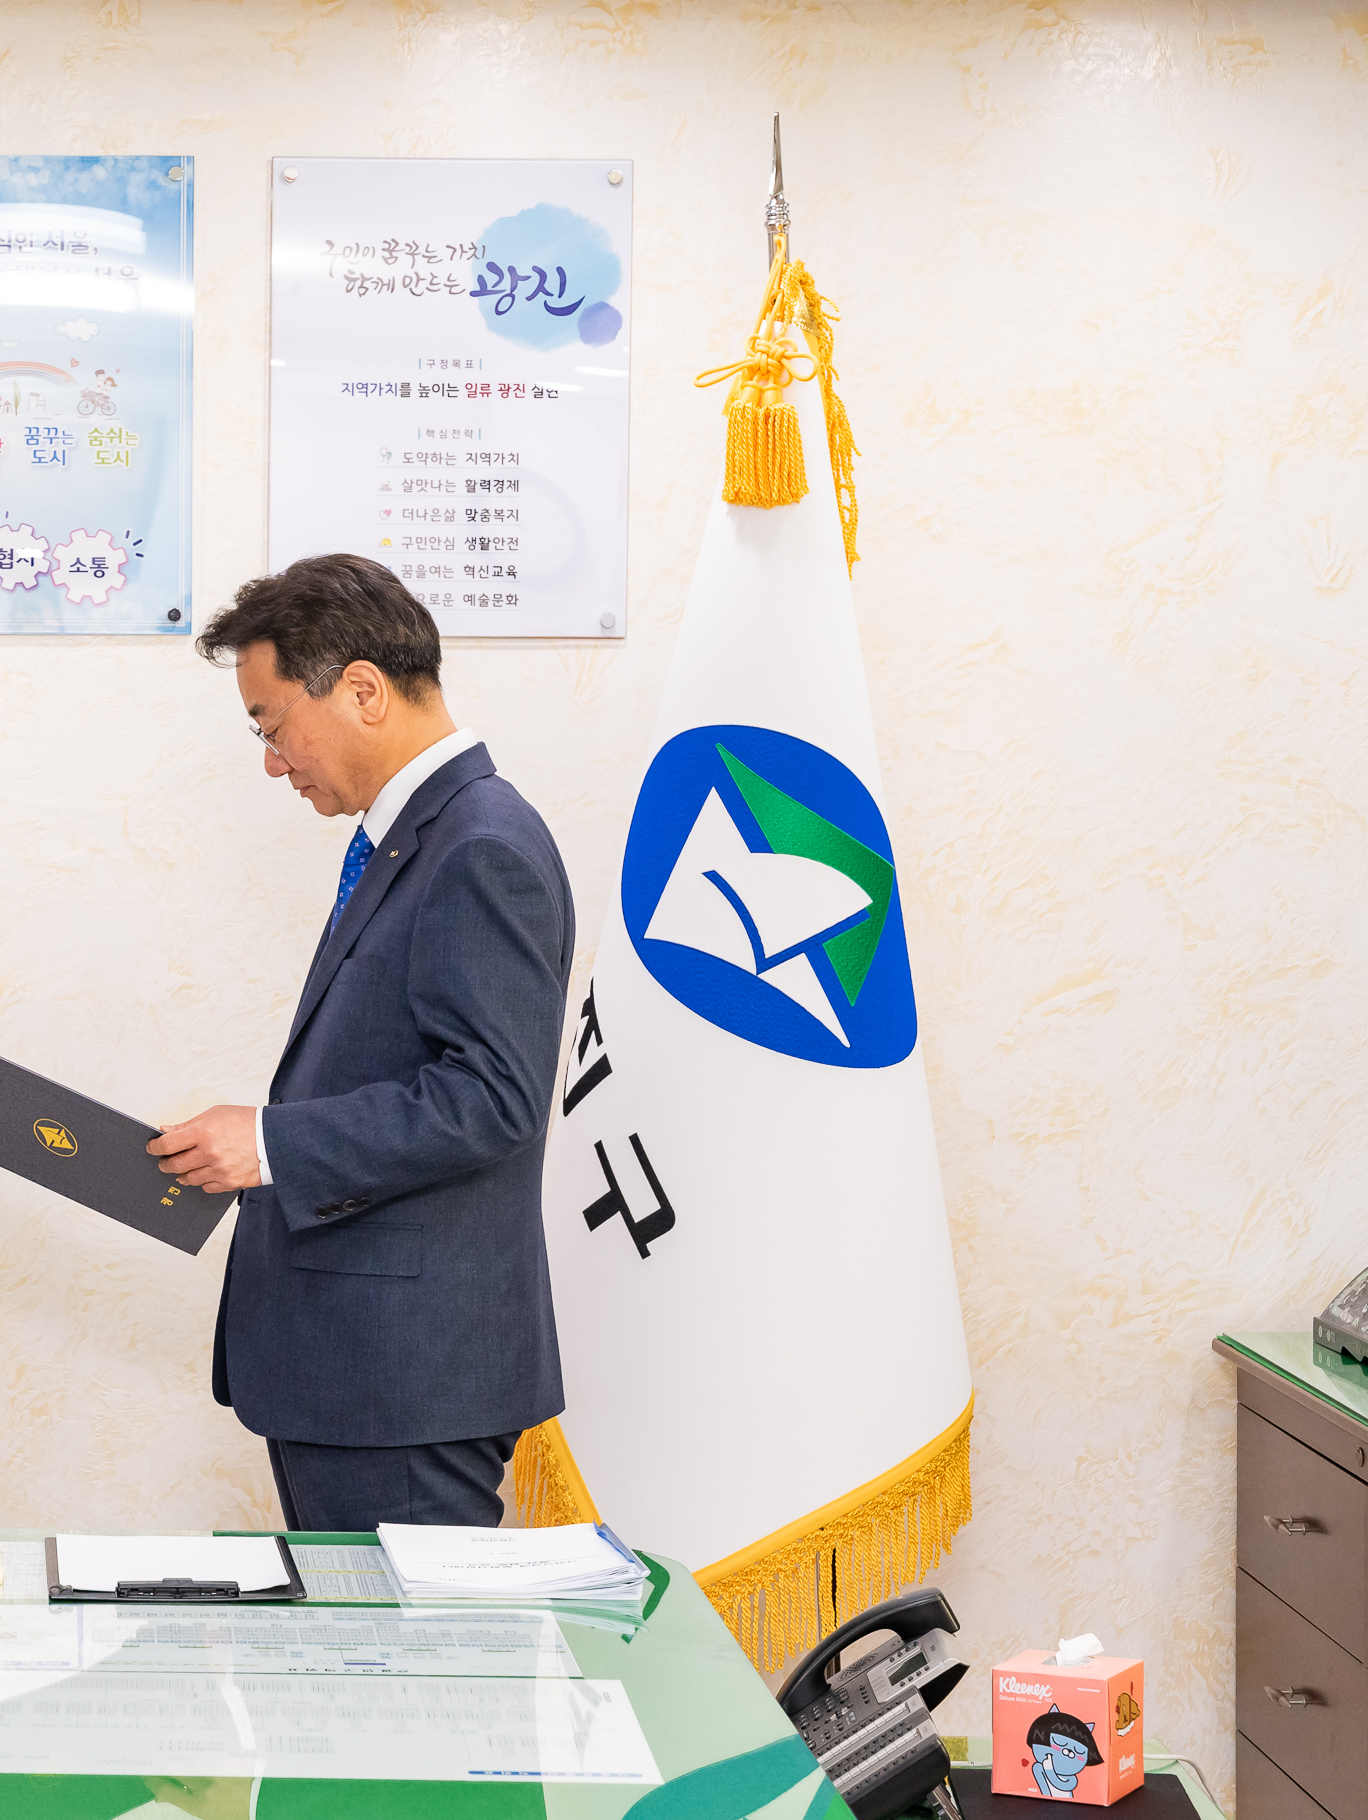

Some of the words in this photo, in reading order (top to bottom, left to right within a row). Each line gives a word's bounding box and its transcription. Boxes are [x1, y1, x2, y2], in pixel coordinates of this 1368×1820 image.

[382, 238, 443, 269] 꿈꾸는
[446, 242, 486, 261] 가치
[343, 268, 395, 297] 함께
[402, 271, 466, 297] 만드는
[470, 262, 586, 316] 광진
[426, 359, 474, 370] 구정목표
[341, 382, 412, 398] 지역가치를
[418, 382, 459, 398] 높이는
[465, 382, 492, 398] 일류
[498, 383, 525, 399] 광진
[24, 426, 75, 445] 꿈꾸는
[87, 427, 139, 447] 숨쉬는
[425, 429, 474, 440] 핵심전략
[31, 449, 66, 466] 도시
[94, 450, 130, 467] 도시
[402, 451, 457, 466] 도약하는
[466, 452, 520, 466] 지역가치
[401, 479, 457, 493] 살맛나는
[465, 479, 519, 494] 활력경제
[402, 508, 456, 522] 더나은삶
[465, 508, 519, 523] 맞춤복지
[401, 536, 455, 550] 구민안심
[464, 537, 519, 551] 생활안전
[69, 557, 110, 578] 소통
[401, 564, 455, 579] 꿈을여는
[464, 565, 518, 579] 혁신교육
[415, 593, 454, 607] 요로운
[463, 593, 519, 607] 예술문화
[999, 1676, 1052, 1700] Kleenex
